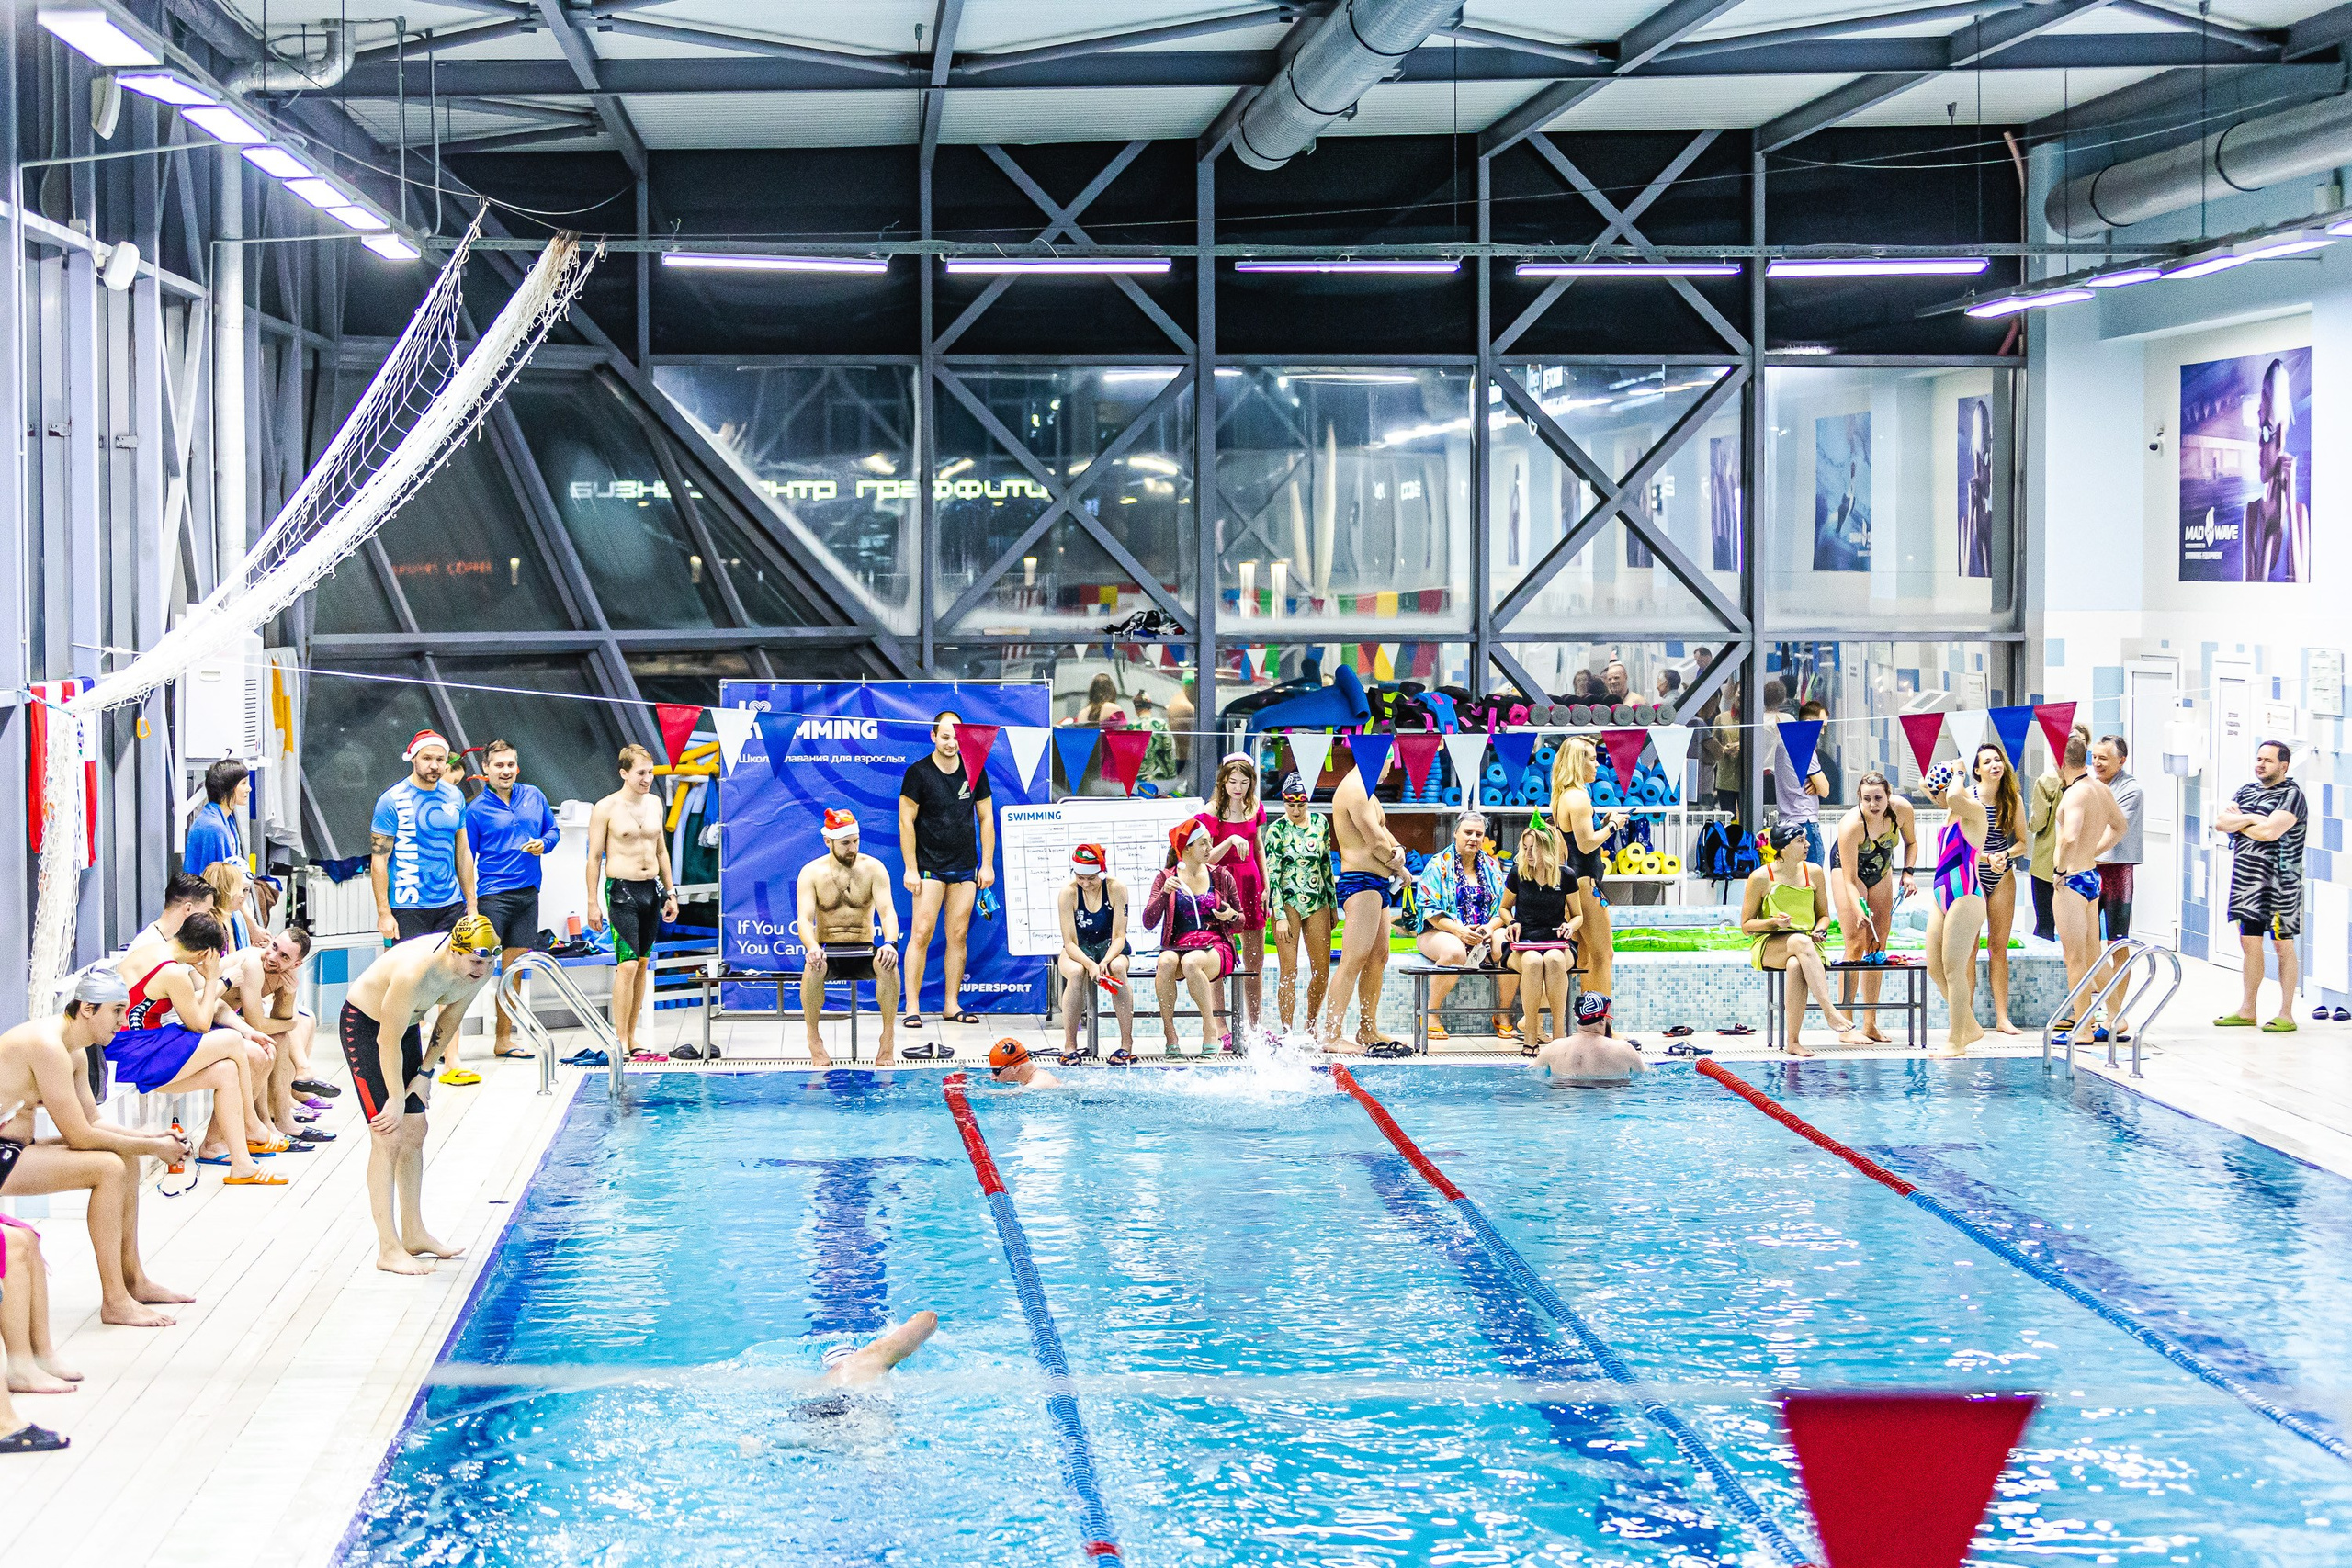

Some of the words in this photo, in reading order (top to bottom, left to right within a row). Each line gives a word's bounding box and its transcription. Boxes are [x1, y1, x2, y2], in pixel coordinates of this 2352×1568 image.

[2185, 525, 2205, 541] MAD
[2214, 525, 2239, 541] WAVE
[746, 720, 878, 740] MMING
[739, 753, 770, 763] Школ
[784, 755, 829, 763] лавания
[831, 755, 852, 764] для
[854, 755, 906, 765] взрослых
[1007, 810, 1062, 822] SWIMMING
[738, 920, 750, 935] If
[752, 920, 784, 936] You
[737, 940, 770, 955] You
[773, 940, 806, 956] Can
